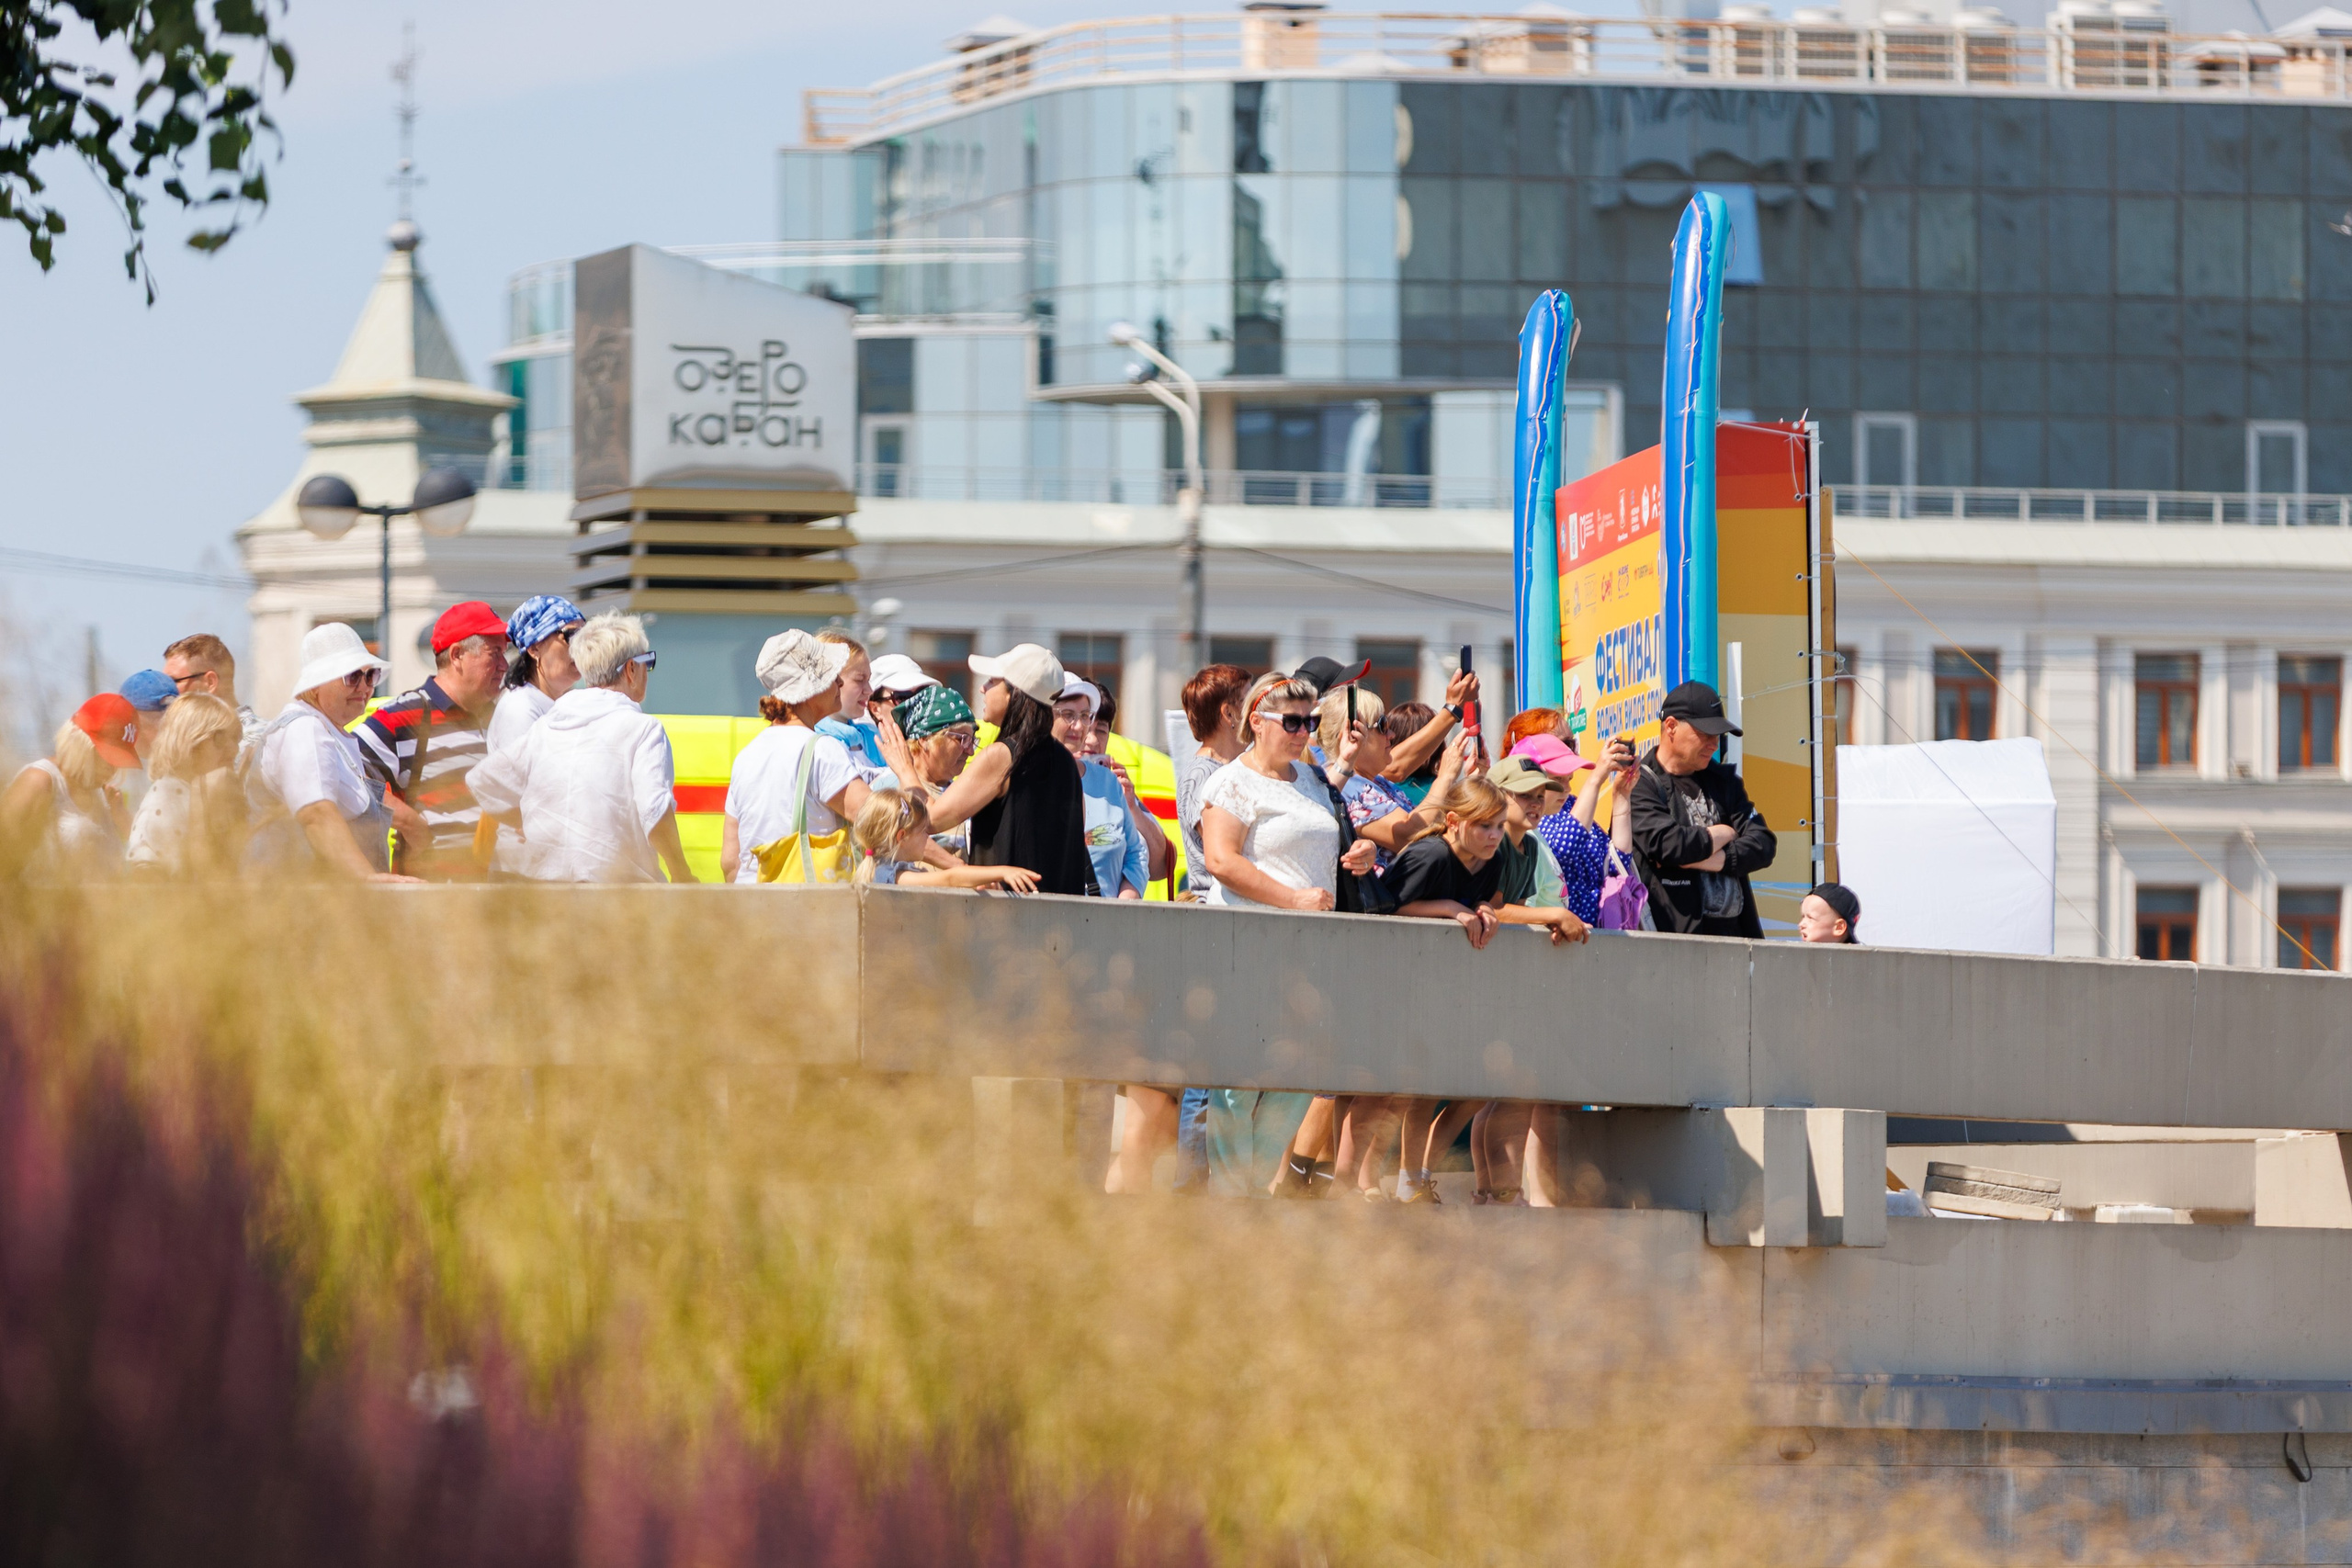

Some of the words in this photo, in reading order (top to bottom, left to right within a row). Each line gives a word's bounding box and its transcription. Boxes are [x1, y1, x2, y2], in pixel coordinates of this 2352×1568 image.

[670, 340, 808, 415] ОЗЕРО
[1596, 614, 1661, 695] ФЕСТИВАЛ
[1597, 702, 1623, 741] ВОДНЫХ
[1624, 694, 1645, 732] ВИДОВ
